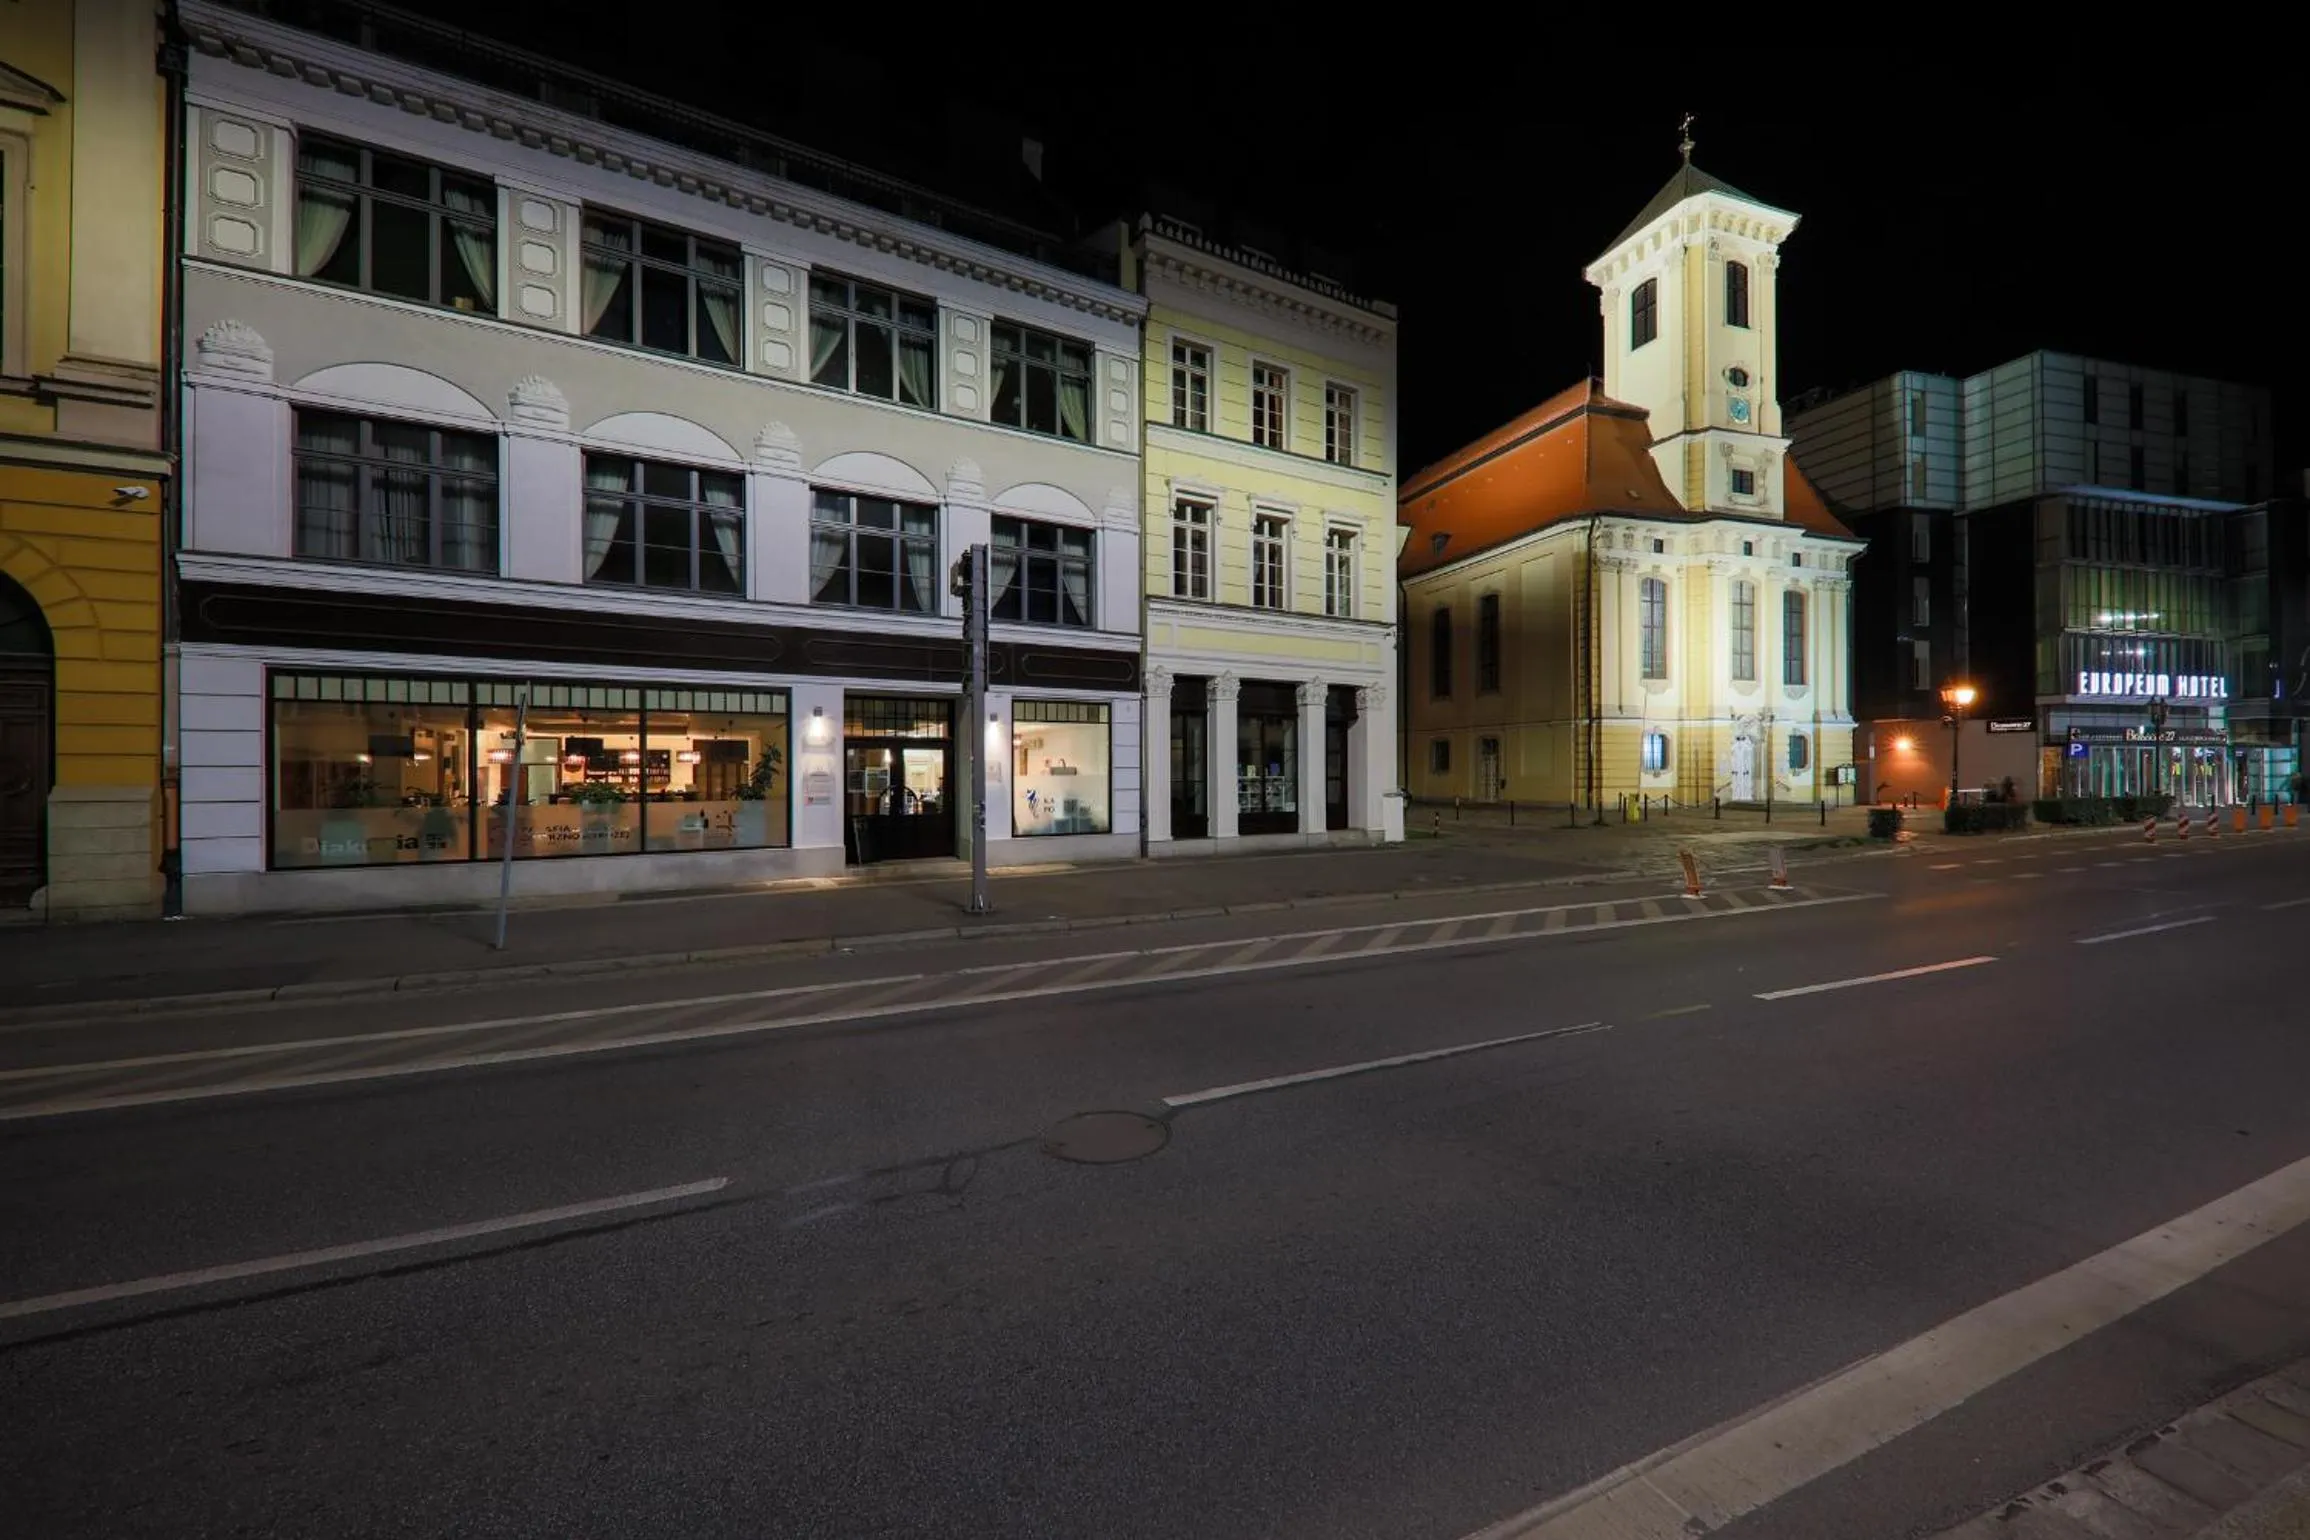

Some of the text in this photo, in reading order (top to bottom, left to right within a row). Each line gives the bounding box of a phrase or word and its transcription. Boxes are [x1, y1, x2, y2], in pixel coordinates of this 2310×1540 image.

[2079, 671, 2228, 698] EUROPEUM HOTEL
[2070, 743, 2083, 757] P
